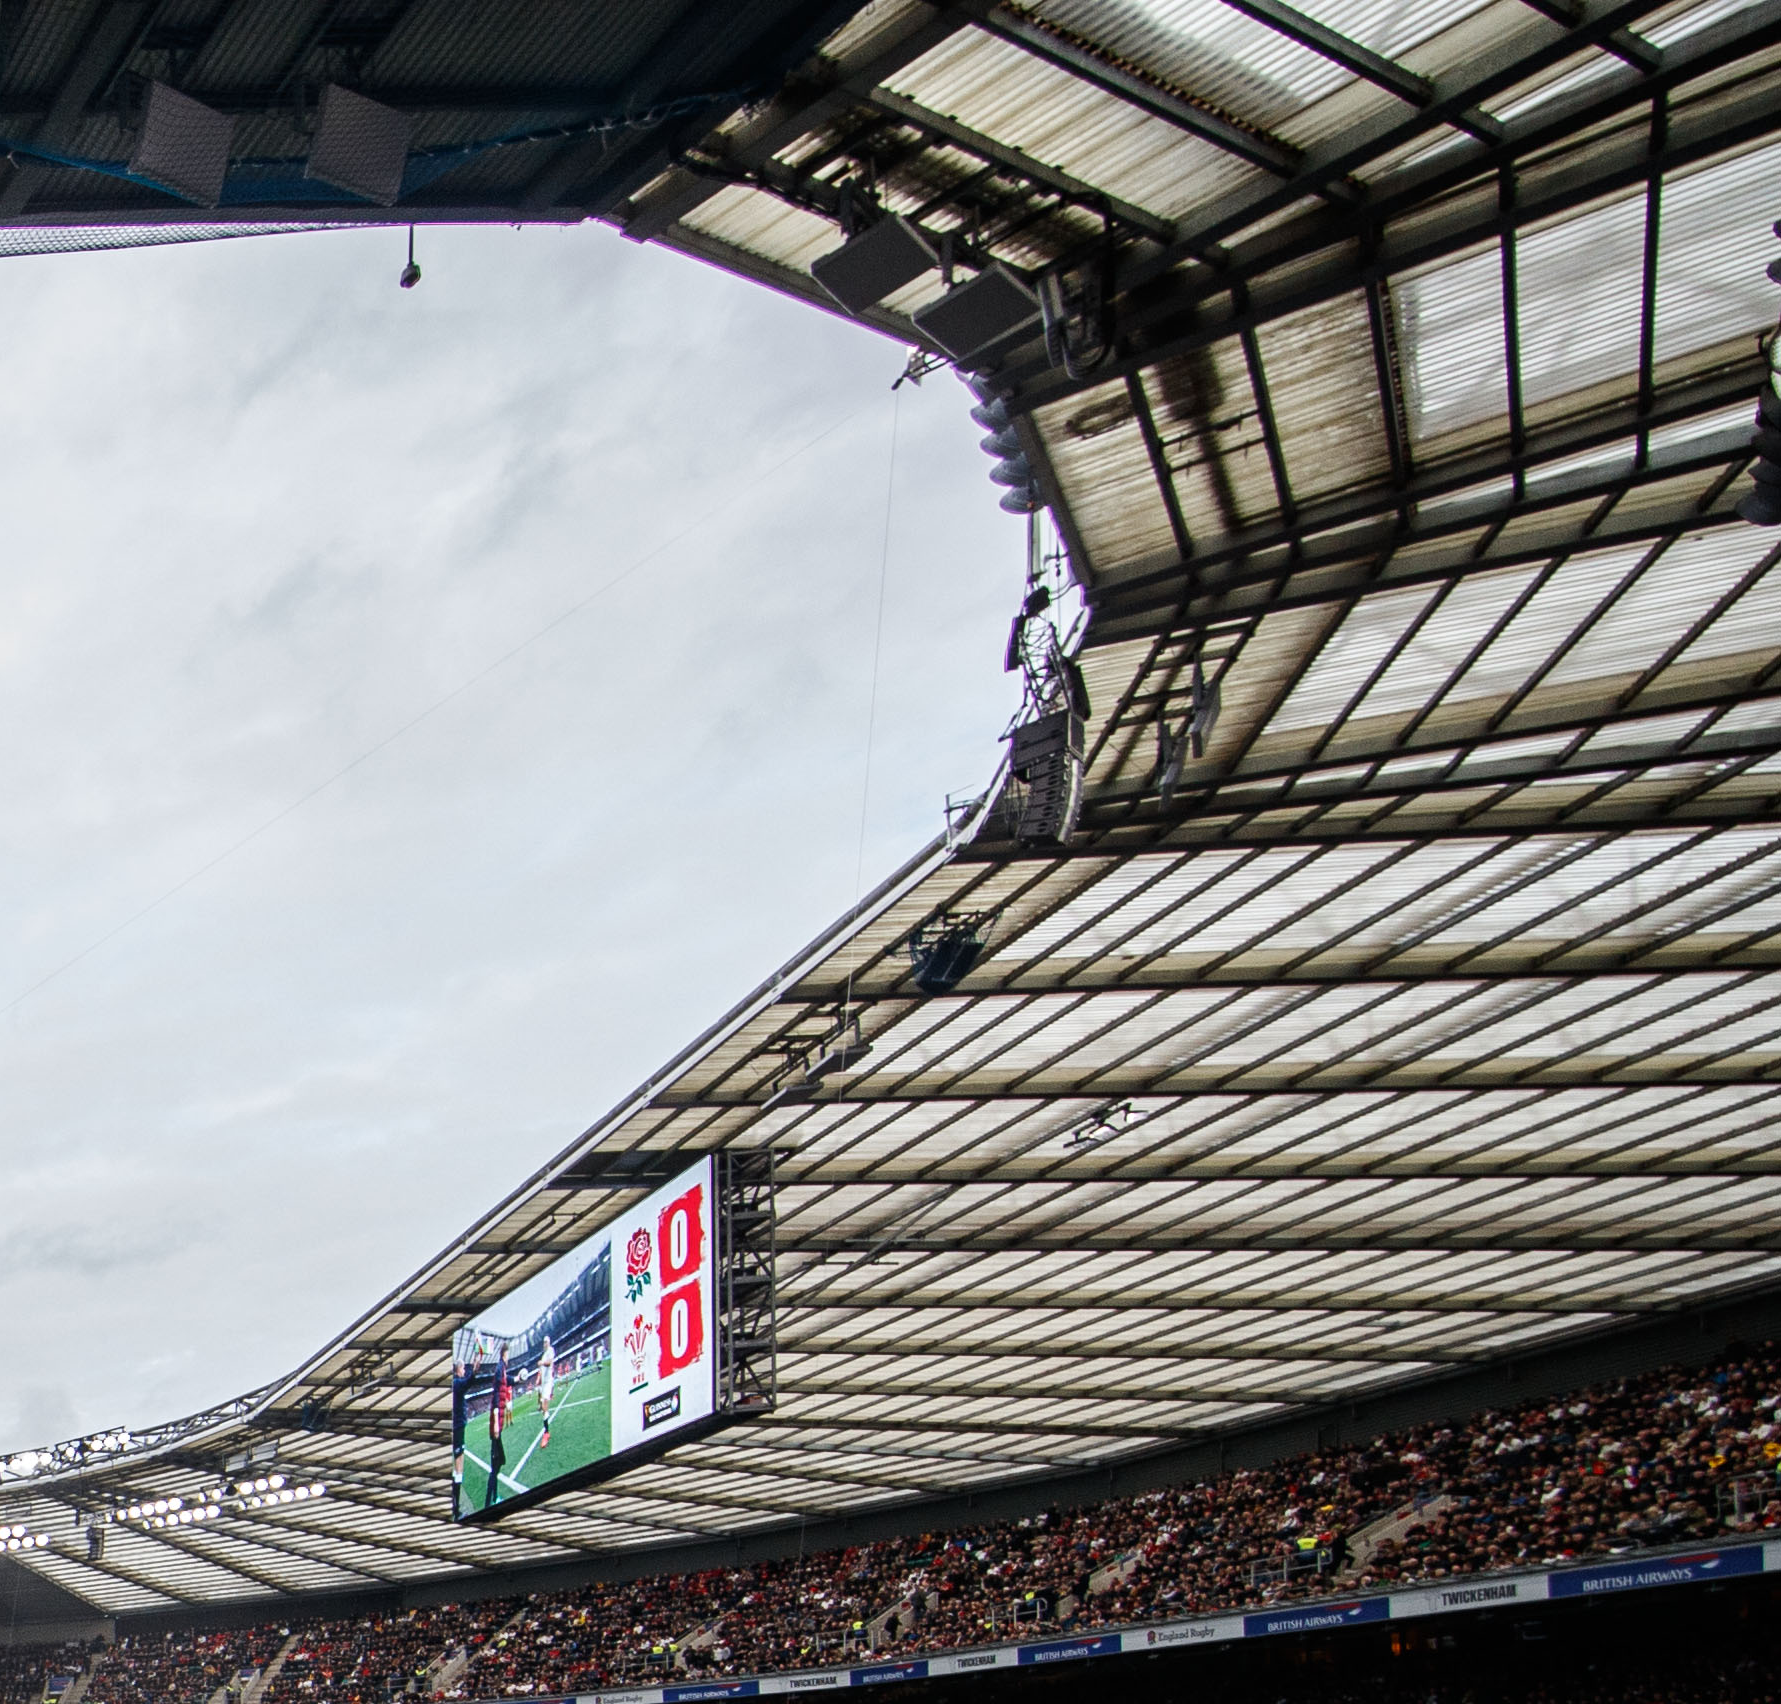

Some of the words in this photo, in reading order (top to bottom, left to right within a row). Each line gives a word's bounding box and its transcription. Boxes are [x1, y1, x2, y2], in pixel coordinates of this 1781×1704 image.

[670, 1208, 689, 1270] 0
[670, 1298, 689, 1359] 0
[1583, 1574, 1633, 1591] BRITISH
[1635, 1568, 1692, 1585] AIRWAYS
[1441, 1584, 1516, 1606] TWICKENHAM
[1267, 1619, 1303, 1632] BRITISH
[1304, 1614, 1343, 1627] AIRWAYS
[1158, 1631, 1189, 1643] England
[1190, 1628, 1215, 1641] Rugby
[957, 1655, 996, 1669] TWICKENHAM
[790, 1676, 837, 1688] TWICKENHAM
